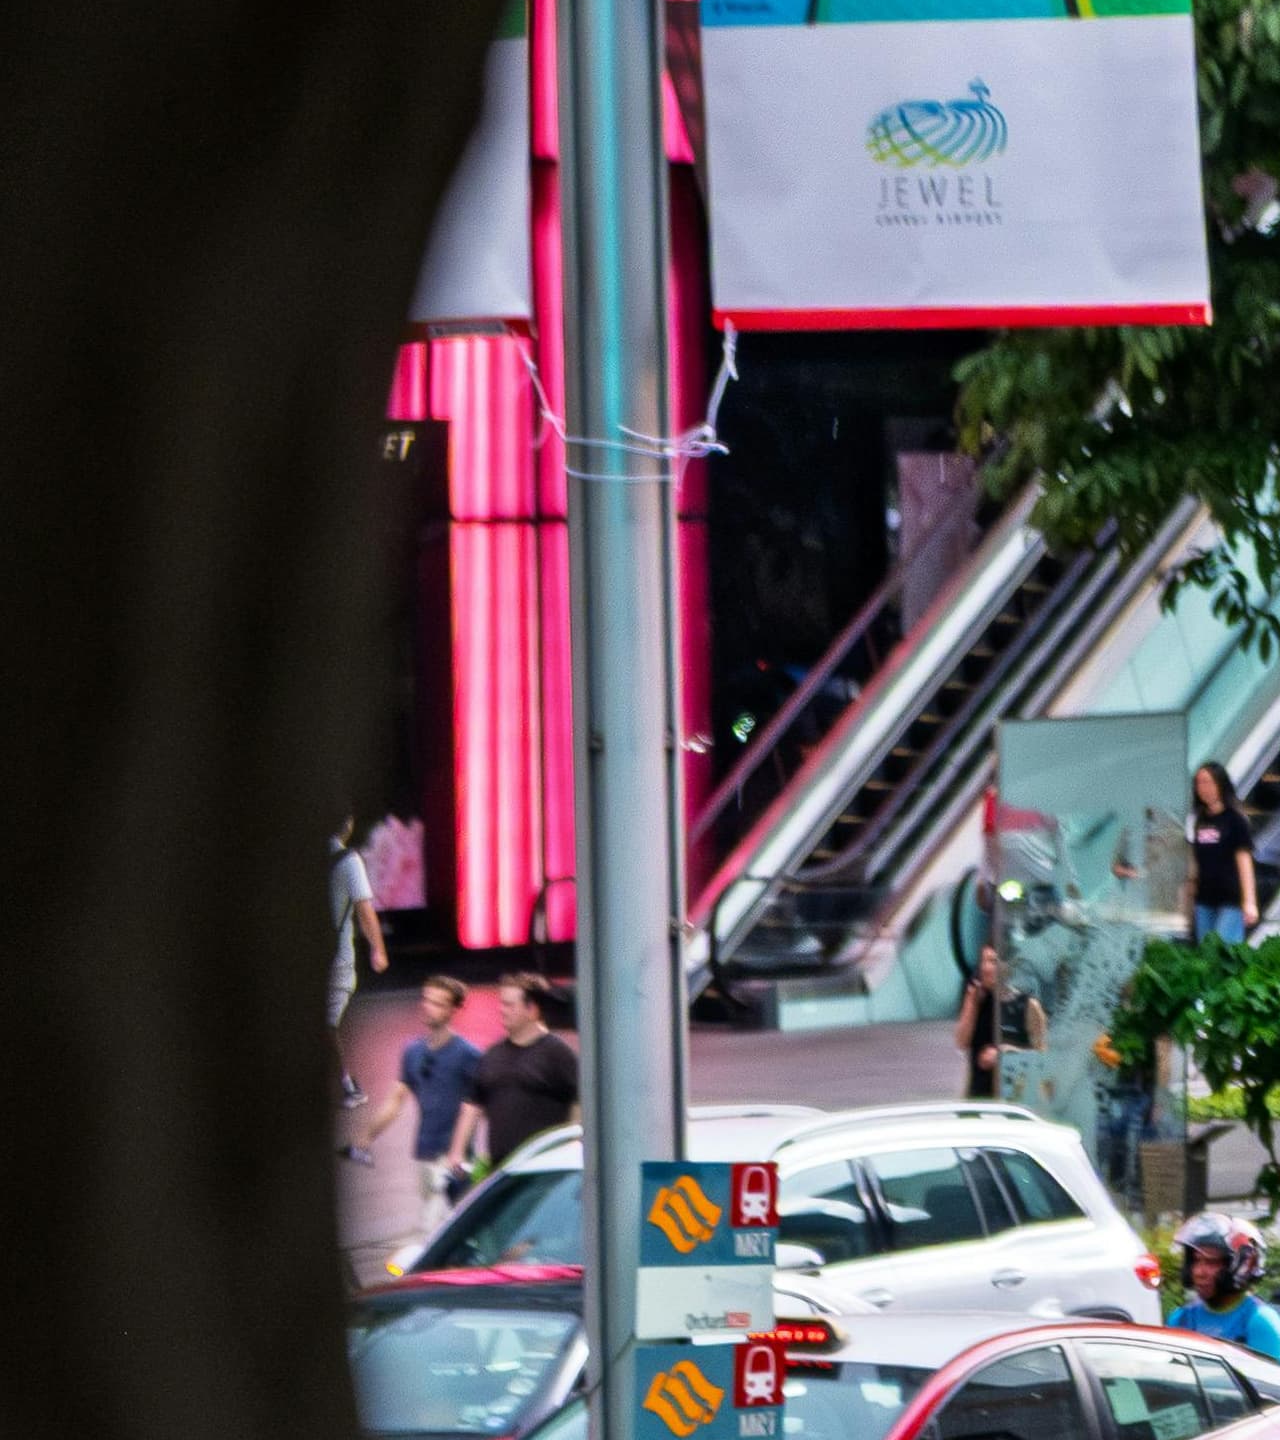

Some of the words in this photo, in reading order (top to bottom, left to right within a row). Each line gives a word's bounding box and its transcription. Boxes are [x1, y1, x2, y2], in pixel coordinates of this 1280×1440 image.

[877, 175, 1003, 209] JEWEL
[734, 1232, 770, 1258] MRT
[739, 1410, 776, 1437] MRT
